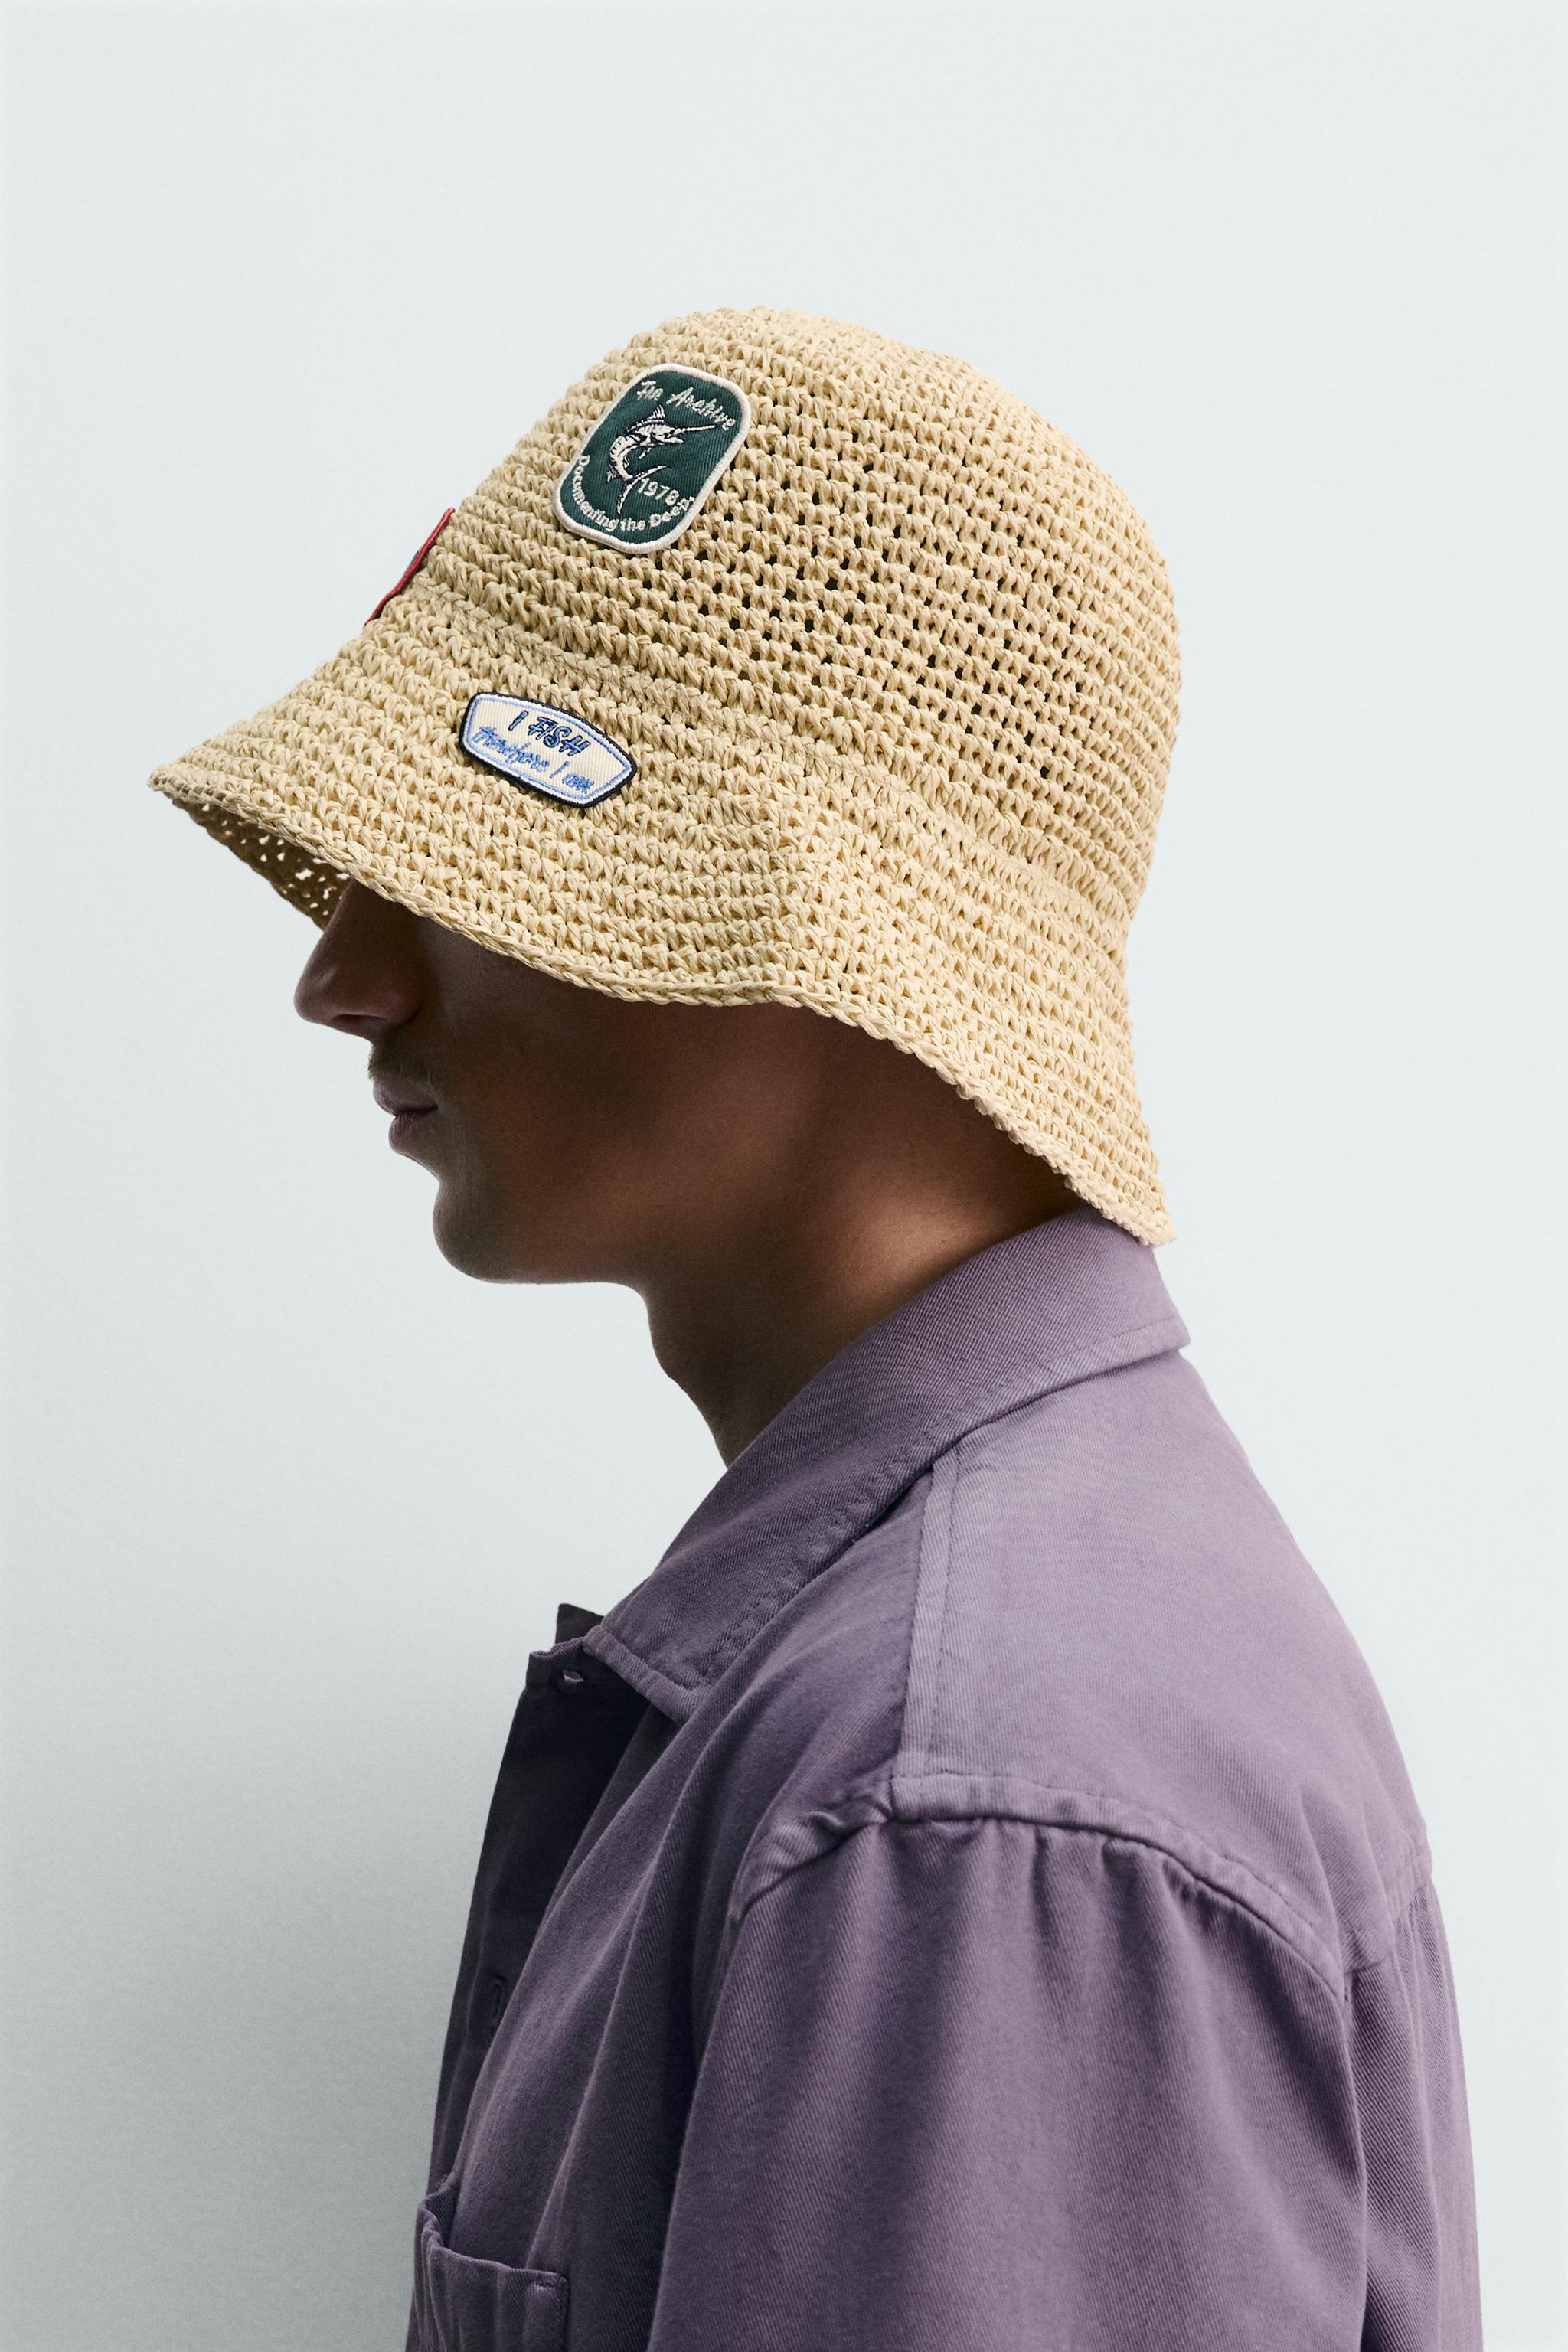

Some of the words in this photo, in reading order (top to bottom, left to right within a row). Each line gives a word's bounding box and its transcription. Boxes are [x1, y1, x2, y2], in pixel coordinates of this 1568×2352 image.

[666, 386, 736, 430] Archive
[572, 454, 619, 531] Documenting
[620, 517, 645, 531] the
[637, 478, 679, 506] 1978
[508, 710, 529, 731] I
